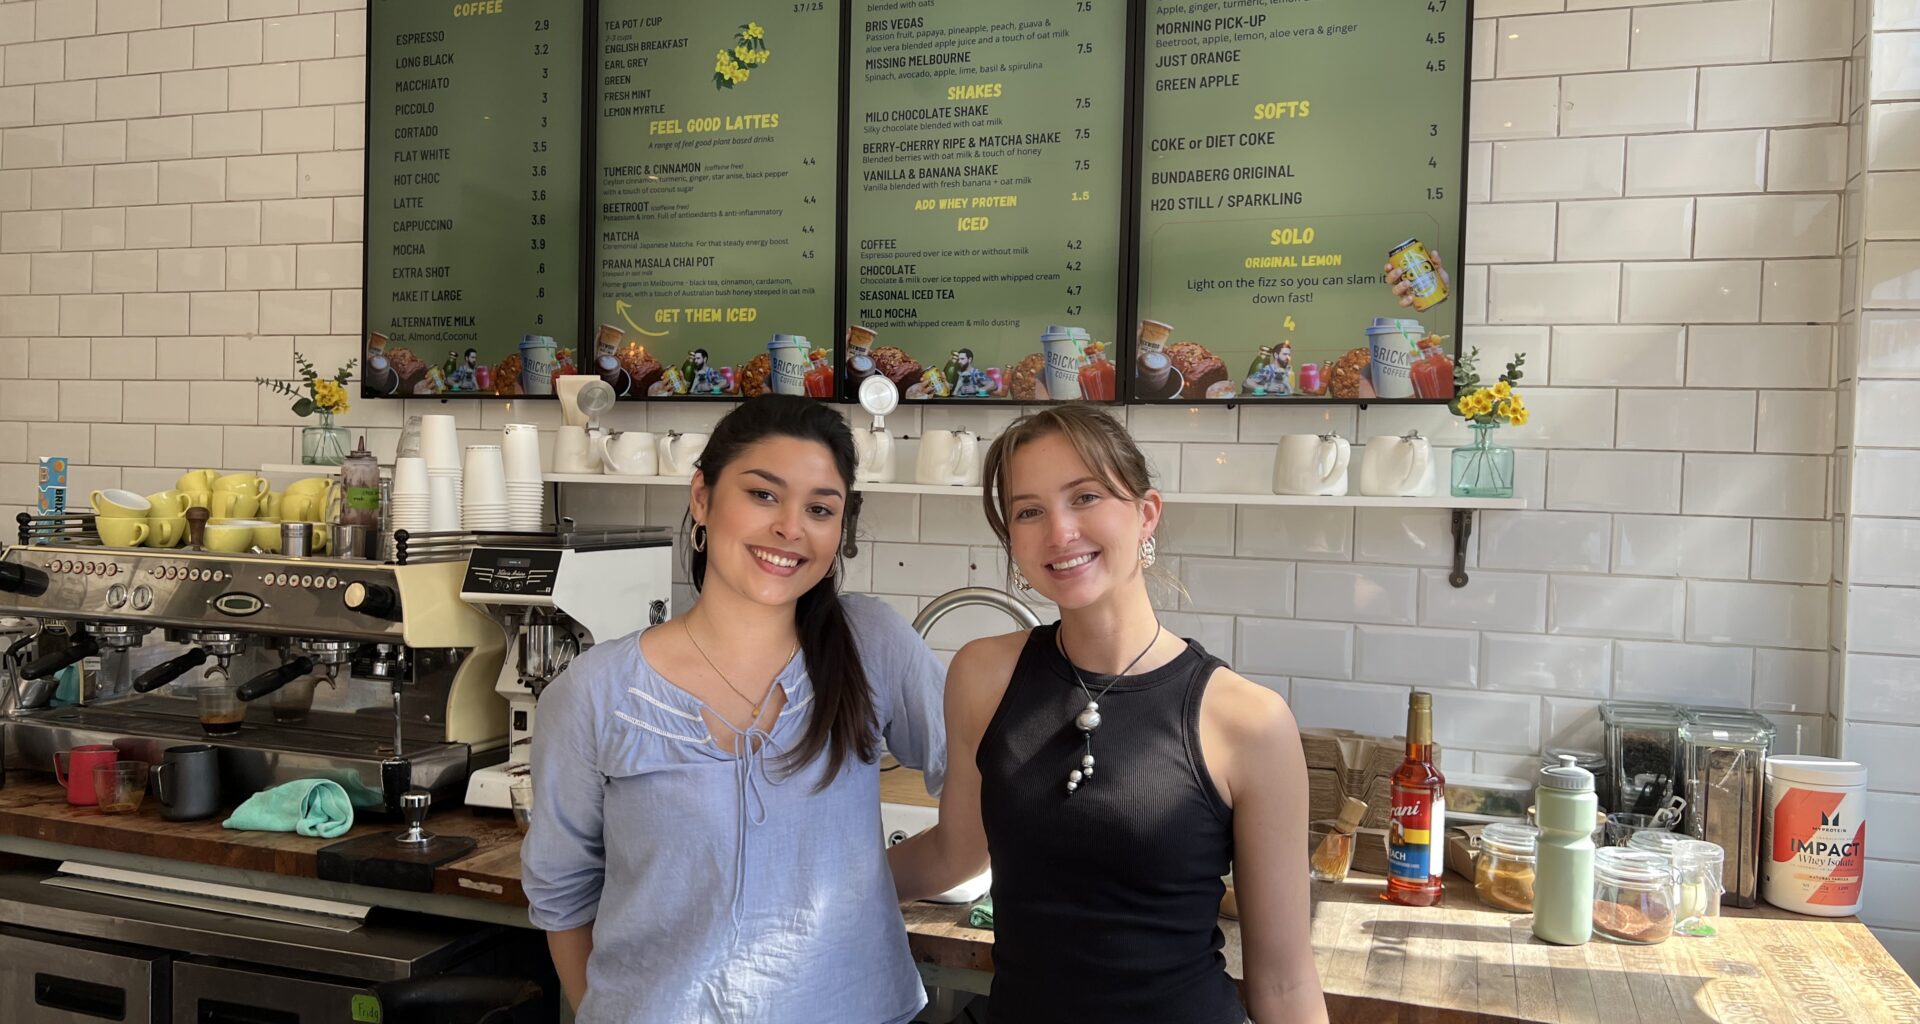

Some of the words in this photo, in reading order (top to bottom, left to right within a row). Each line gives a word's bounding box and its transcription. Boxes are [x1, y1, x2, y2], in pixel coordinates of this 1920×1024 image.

[453, 0, 503, 17] COFFEE
[1077, 2, 1091, 12] 7.5
[1427, 1, 1446, 13] 4.7
[535, 20, 549, 31] 2.9
[866, 21, 888, 32] BRIS
[891, 17, 923, 29] VEGAS
[1157, 19, 1211, 36] MORNING
[1215, 15, 1266, 30] PICK-UP
[396, 31, 444, 46] ESPRESSO
[1156, 38, 1199, 48] Beetroot,
[1202, 35, 1231, 46] apple,
[1234, 32, 1267, 43] lemon,
[1269, 28, 1290, 38] aloe
[1293, 28, 1315, 37] vera
[1317, 26, 1324, 34] &
[1327, 23, 1358, 35] ginger
[1426, 32, 1445, 45] 4.5
[534, 45, 549, 55] 3.2
[605, 42, 639, 54] ENGLISH
[641, 39, 688, 51] BREAKFAST
[1078, 43, 1092, 53] 7.5
[396, 56, 420, 69] LONG
[423, 54, 454, 67] BLACK
[605, 60, 625, 69] EARL
[627, 58, 648, 68] GREY
[866, 56, 906, 69] MISSING
[909, 52, 971, 67] MELBOURNE
[1155, 54, 1187, 68] JUST
[1190, 50, 1240, 65] ORANGE
[1426, 60, 1446, 72] 4.5
[542, 68, 548, 78] 3
[396, 78, 449, 92] MACCHIATO
[605, 76, 631, 85] GREEN
[1156, 77, 1196, 92] GREEN
[1199, 74, 1239, 88] APPLE
[542, 93, 548, 103] 3
[604, 91, 629, 101] FRESH
[632, 90, 651, 99] MINT
[948, 84, 1002, 100] SHAKES
[395, 102, 434, 115] PICCOLO
[1076, 98, 1090, 108] 7.5
[604, 107, 631, 117] LEMON
[633, 105, 665, 115] MYRTLE
[866, 111, 888, 122] MILO
[892, 107, 951, 120] CHOCOLATE
[954, 105, 988, 117] SHAKE
[1254, 100, 1310, 120] SOFTS
[542, 117, 547, 127] 3
[650, 119, 682, 135] FEEL
[687, 117, 721, 133] GOOD
[726, 114, 779, 131] LATTES
[864, 126, 880, 135] Silky
[882, 123, 918, 133] chocolate
[920, 122, 951, 130] blended
[953, 121, 970, 129] with
[972, 120, 985, 128] oat
[987, 118, 1003, 126] milk
[395, 126, 438, 139] CORTADO
[1075, 129, 1090, 139] 7.5
[1430, 125, 1437, 136] 3
[533, 142, 547, 152] 3.5
[863, 139, 939, 154] BERRY-CHERRY
[943, 138, 965, 149] RIPE
[969, 138, 976, 148] &
[980, 135, 1022, 147] MATCHA
[1025, 133, 1060, 144] SHAKE
[1152, 138, 1185, 152] COKE
[1189, 139, 1202, 150] or
[1206, 134, 1235, 148] DIET
[1239, 132, 1275, 146] COKE
[395, 151, 417, 162] FLAT
[420, 149, 450, 161] WHITE
[803, 158, 815, 166] 4.4
[1075, 160, 1090, 170] 7.5
[1429, 157, 1437, 168] 4
[532, 166, 546, 176] 3.6
[604, 165, 642, 177] TUMERIC
[644, 166, 651, 175] &
[653, 163, 700, 174] CINNAMON
[864, 169, 905, 181] VANILLA
[908, 169, 916, 179] &
[919, 167, 961, 178] BANANA
[964, 165, 999, 176] SHAKE
[1152, 169, 1229, 185] BUNDABERG
[1233, 165, 1294, 180] ORIGINAL
[394, 174, 412, 186] HOT
[415, 173, 440, 184] CHOC
[532, 191, 546, 201] 3.6
[804, 196, 816, 204] 4.4
[1072, 192, 1089, 201] 1.5
[394, 197, 423, 209] LATTE
[603, 202, 648, 213] BEETROOT
[915, 199, 935, 211] ADD
[939, 198, 968, 209] WHEY
[972, 195, 1017, 209] PROTEIN
[393, 220, 453, 232] CAPPUCCINO
[532, 215, 546, 225] 3.6
[958, 217, 989, 232] ICED
[603, 231, 639, 242] MATCHA
[1271, 227, 1314, 246] SOLO
[393, 244, 425, 255] MOCHA
[531, 239, 545, 250] 3.9
[861, 239, 896, 249] COFFEE
[1067, 240, 1082, 250] 4.2
[802, 251, 814, 259] 4.5
[603, 258, 632, 269] PRANA
[635, 258, 671, 268] MASALA
[673, 257, 694, 267] CHAI
[697, 257, 714, 266] POT
[1066, 262, 1081, 271] 4.2
[1245, 256, 1297, 268] ORIGINAL
[1302, 255, 1342, 267] LEMON
[393, 268, 423, 279] EXTRA
[426, 267, 450, 277] SHOT
[860, 265, 916, 275] CHOCOLATE
[1187, 279, 1214, 291] Light
[1218, 279, 1233, 288] on
[1236, 277, 1255, 288] the
[1258, 276, 1277, 287] fizz
[1280, 277, 1294, 286] so
[1297, 277, 1319, 288] you
[1323, 276, 1344, 285] can
[1347, 273, 1372, 285] slam
[1375, 273, 1386, 284] it
[393, 291, 417, 302] MAKE
[420, 291, 428, 301] IT
[432, 290, 462, 300] LARGE
[860, 290, 909, 300] SEASONAL
[912, 290, 933, 299] ICED
[936, 289, 954, 299] TEA
[1067, 286, 1081, 295] 4.7
[1253, 293, 1285, 304] down
[1288, 291, 1313, 303] fast!
[655, 309, 680, 322] GET
[685, 308, 722, 322] THEM
[727, 308, 757, 321] ICED
[860, 309, 882, 318] MILO
[885, 308, 917, 318] MOCHA
[1067, 306, 1081, 315] 4.7
[391, 317, 451, 327] ALTERNATIVE
[454, 316, 475, 326] MILK
[1283, 316, 1295, 331] 4
[1791, 838, 1860, 857] IMPACT
[1390, 849, 1406, 861] ACH
[1798, 854, 1826, 867] Whey
[1827, 857, 1854, 867] Isolate
